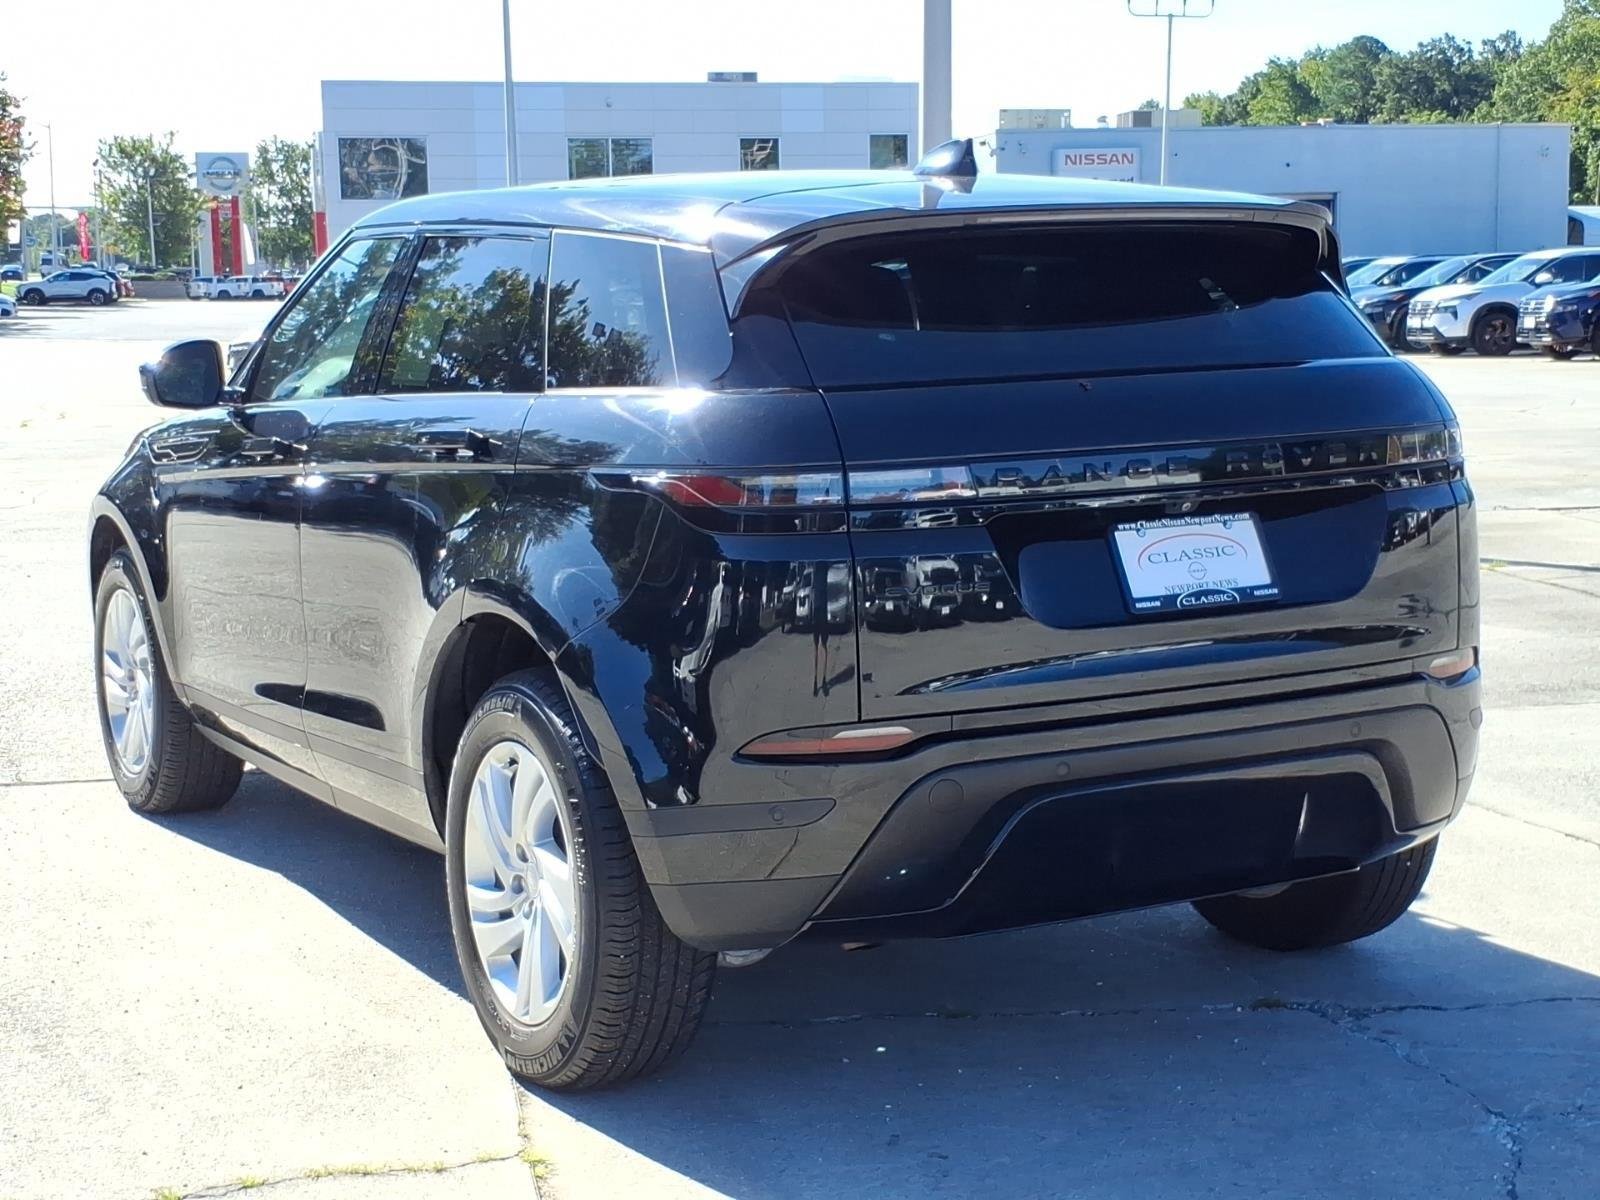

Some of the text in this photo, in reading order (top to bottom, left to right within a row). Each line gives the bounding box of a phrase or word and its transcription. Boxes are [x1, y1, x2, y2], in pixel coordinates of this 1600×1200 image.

[1064, 153, 1134, 166] NISSAN
[994, 454, 1190, 487] RANGE
[1147, 545, 1237, 565] CLASSIC
[1164, 578, 1239, 595] NEWPORT NEWS
[1253, 587, 1279, 596] NISSAN
[1135, 600, 1161, 609] NISSAN
[1182, 593, 1233, 606] CLASSIC
[504, 1044, 563, 1075] MICHELIN
